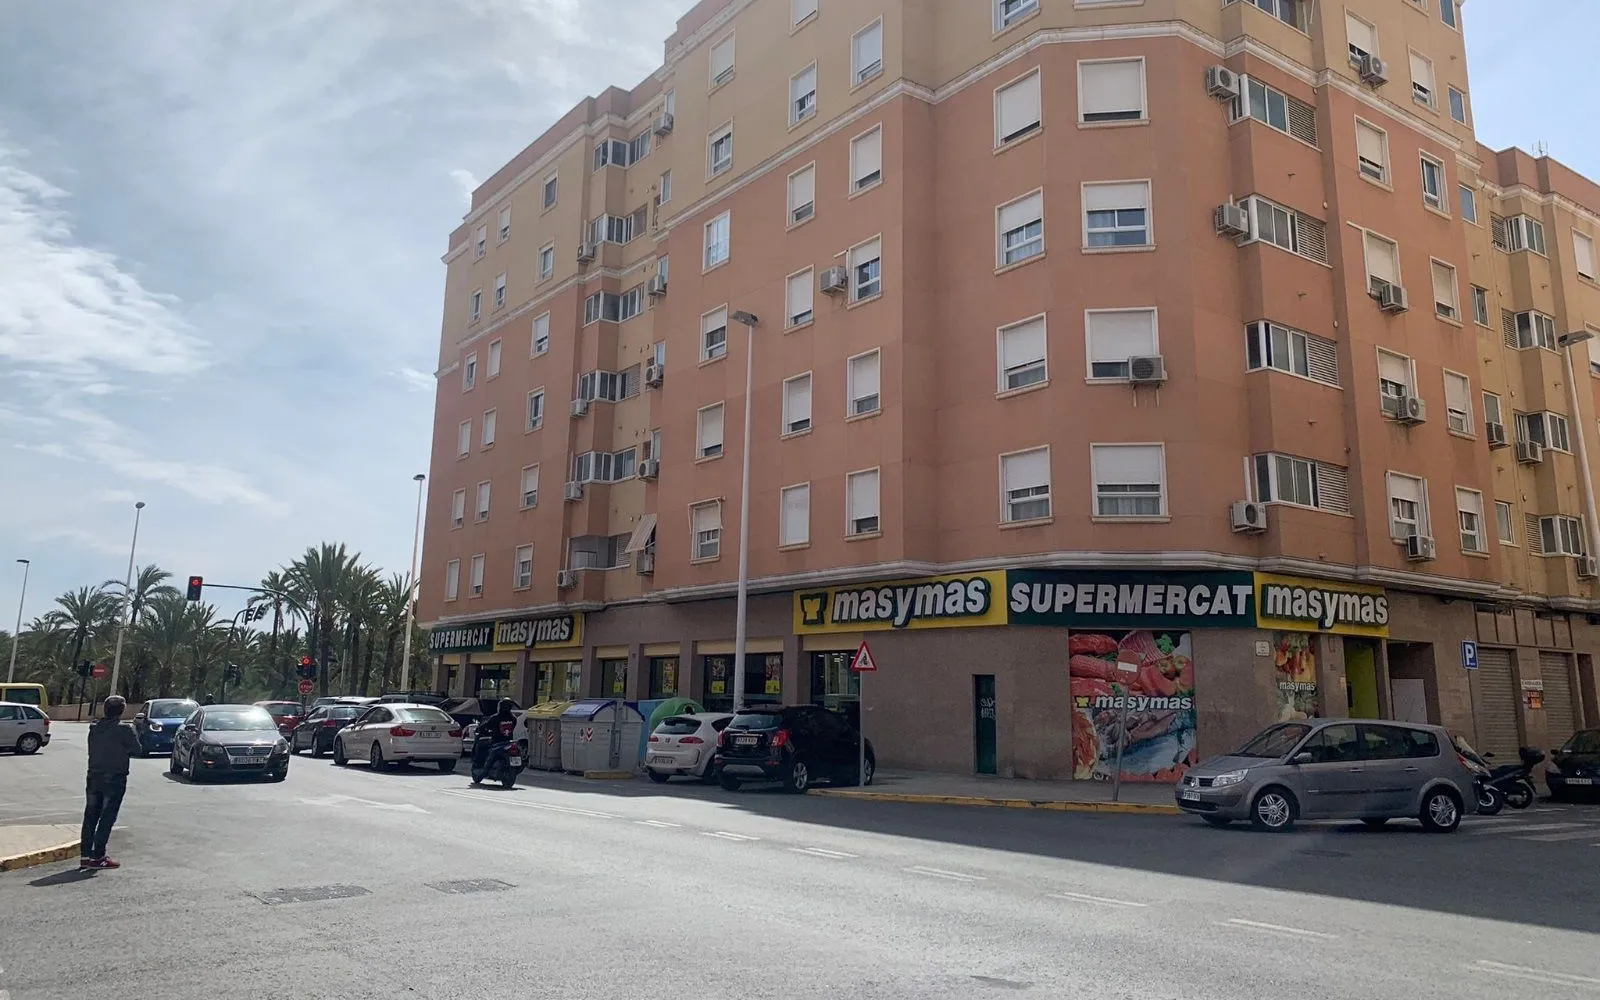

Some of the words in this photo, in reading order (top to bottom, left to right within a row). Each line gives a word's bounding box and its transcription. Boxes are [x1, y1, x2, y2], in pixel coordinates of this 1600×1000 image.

[833, 578, 986, 626] masymas
[1010, 582, 1253, 616] SUPERMERCAT
[1266, 585, 1389, 628] masymas
[429, 627, 490, 649] SUPERMERCAT
[498, 616, 571, 647] masymas
[1465, 643, 1475, 666] P
[1280, 681, 1315, 692] masymas
[1095, 695, 1192, 712] masymas
